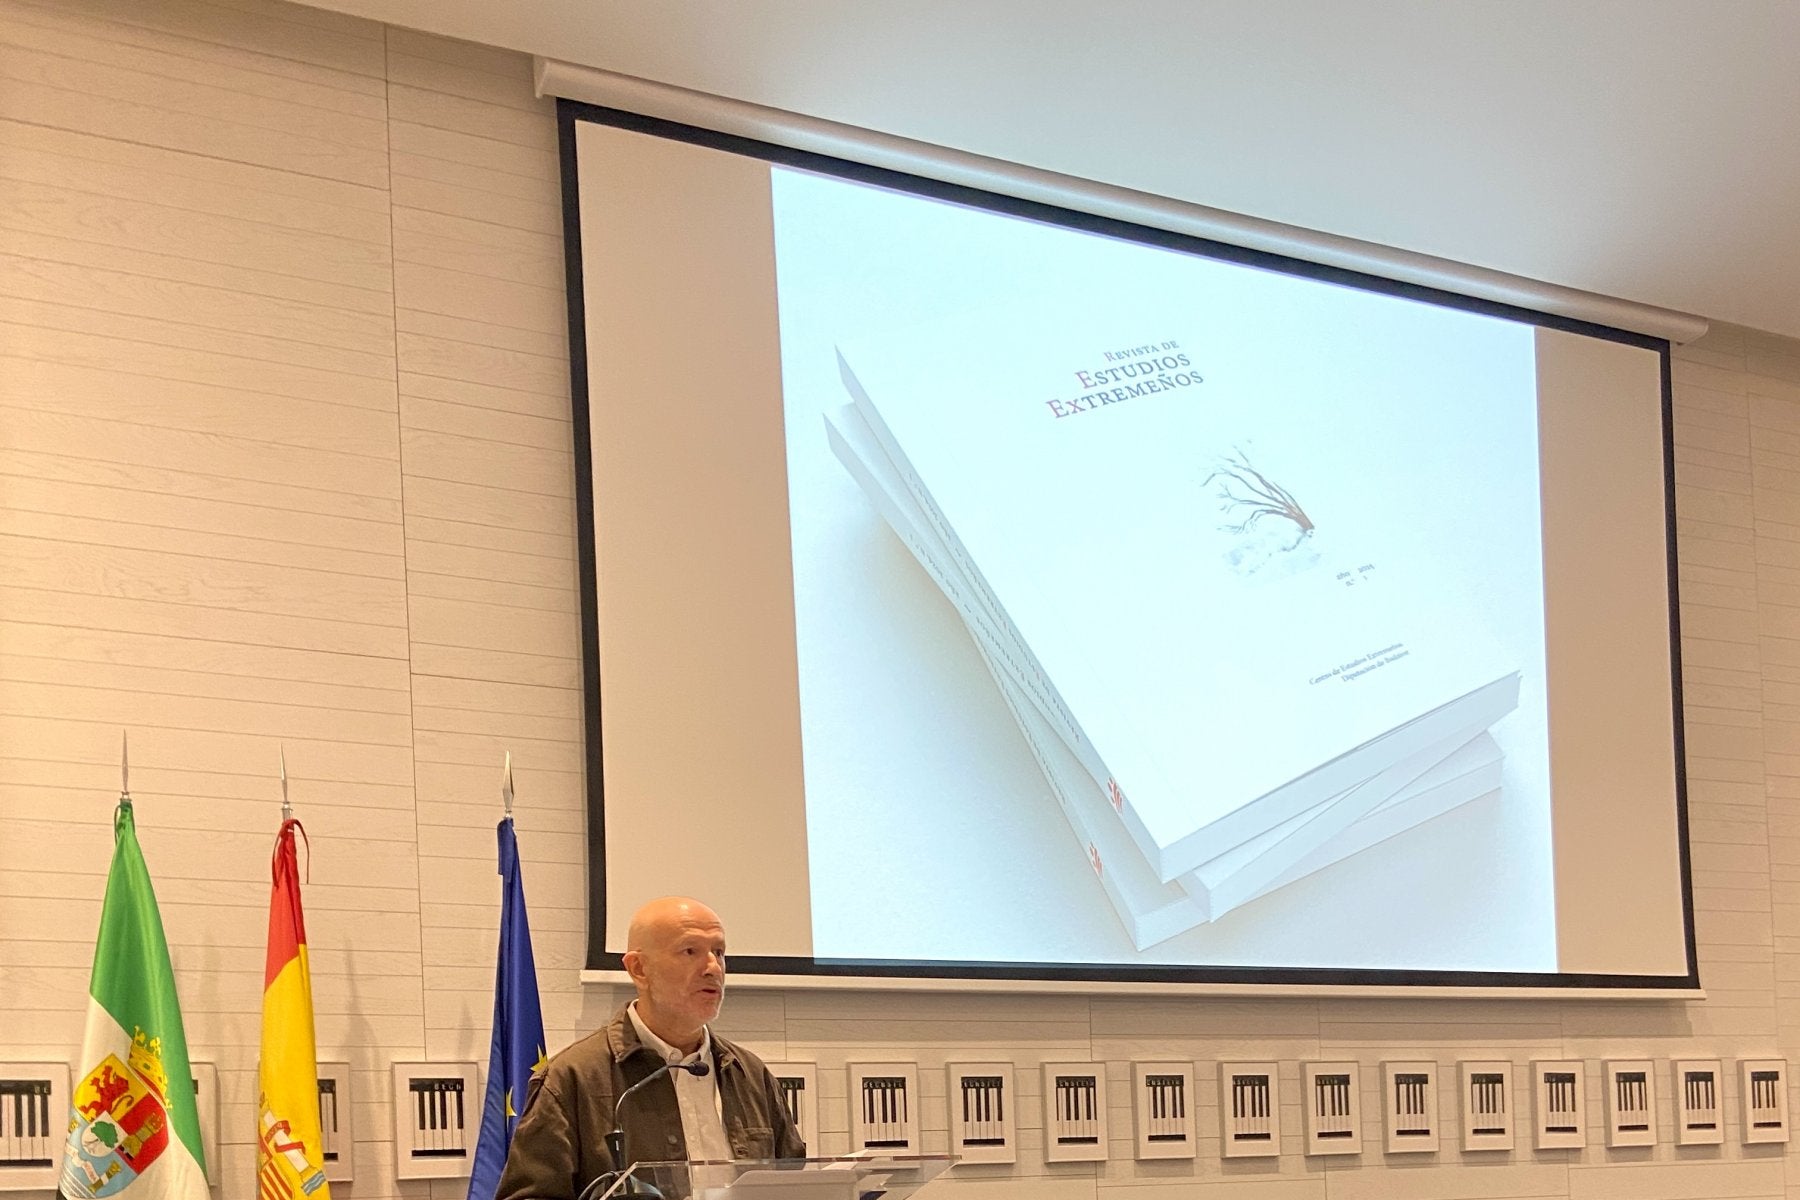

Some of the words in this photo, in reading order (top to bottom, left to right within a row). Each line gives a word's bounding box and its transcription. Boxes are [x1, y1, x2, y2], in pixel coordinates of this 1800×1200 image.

[1103, 345, 1160, 362] REVISTA
[1161, 340, 1180, 351] DE
[1074, 353, 1191, 389] ESTUDIOS
[1045, 370, 1204, 419] EXTREMEÑOS
